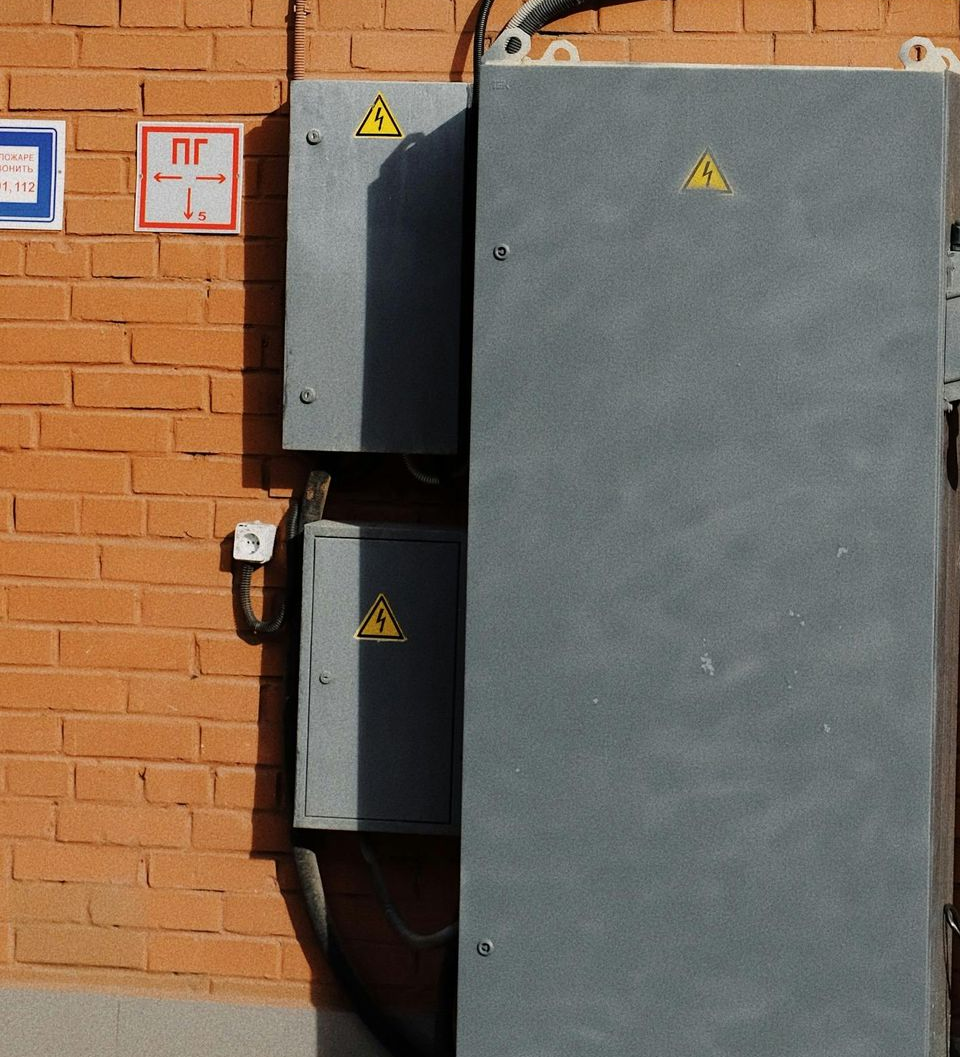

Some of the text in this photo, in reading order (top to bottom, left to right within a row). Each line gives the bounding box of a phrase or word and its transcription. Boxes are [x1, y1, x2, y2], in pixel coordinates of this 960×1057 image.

[172, 137, 208, 165] ПГ
[0, 181, 35, 193] 1, 112
[198, 211, 207, 221] 5
